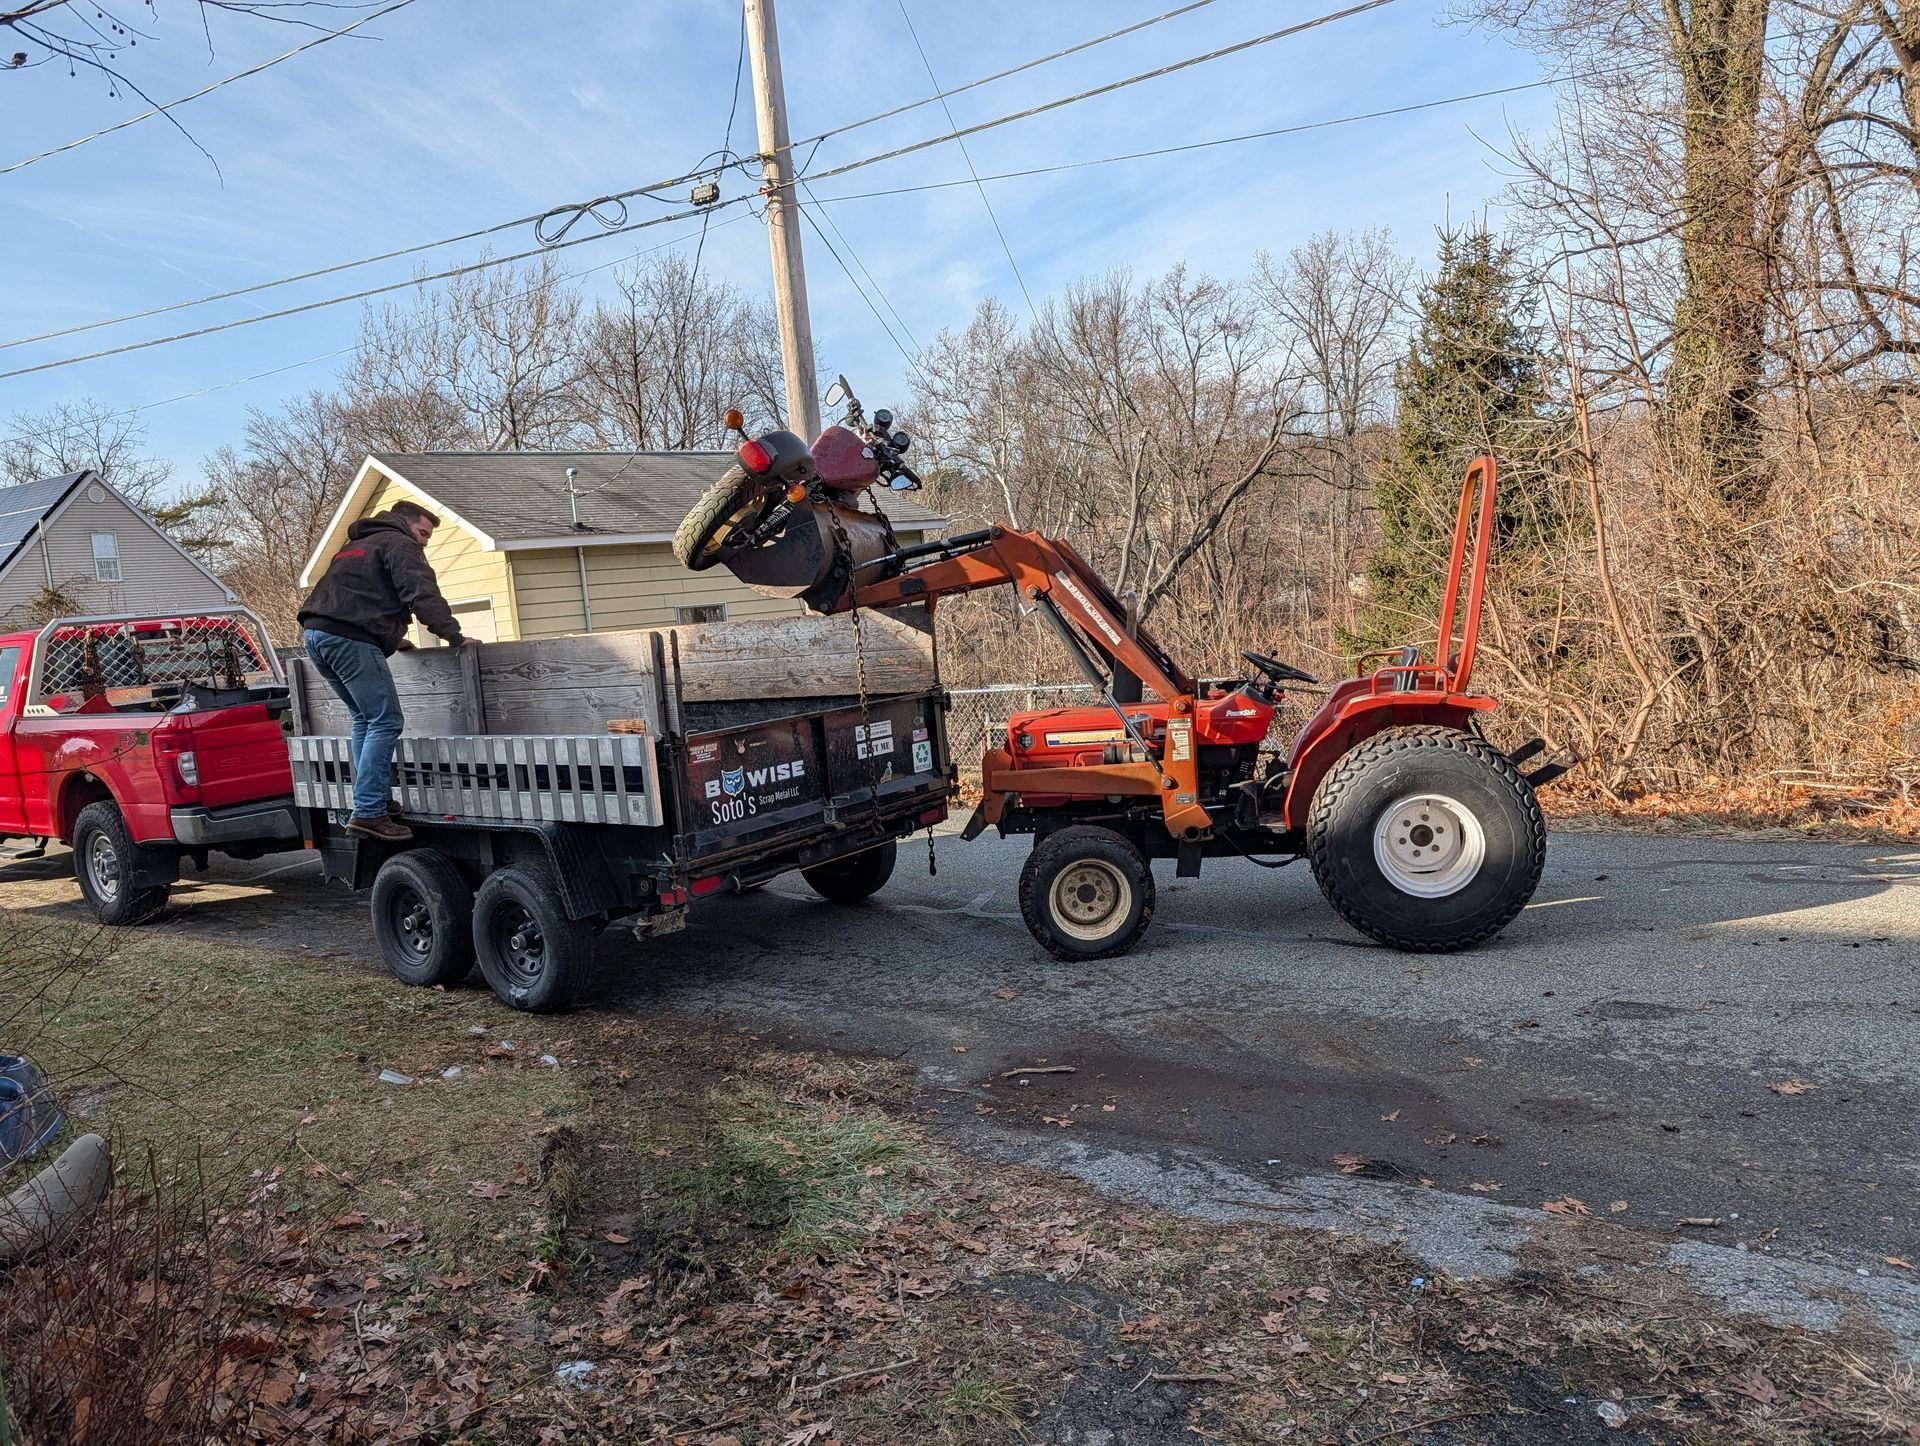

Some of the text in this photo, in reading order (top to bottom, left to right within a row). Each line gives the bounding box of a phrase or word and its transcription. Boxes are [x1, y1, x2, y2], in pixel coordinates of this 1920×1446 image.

[711, 786, 800, 825] Soto's Scrap Metal LLC
